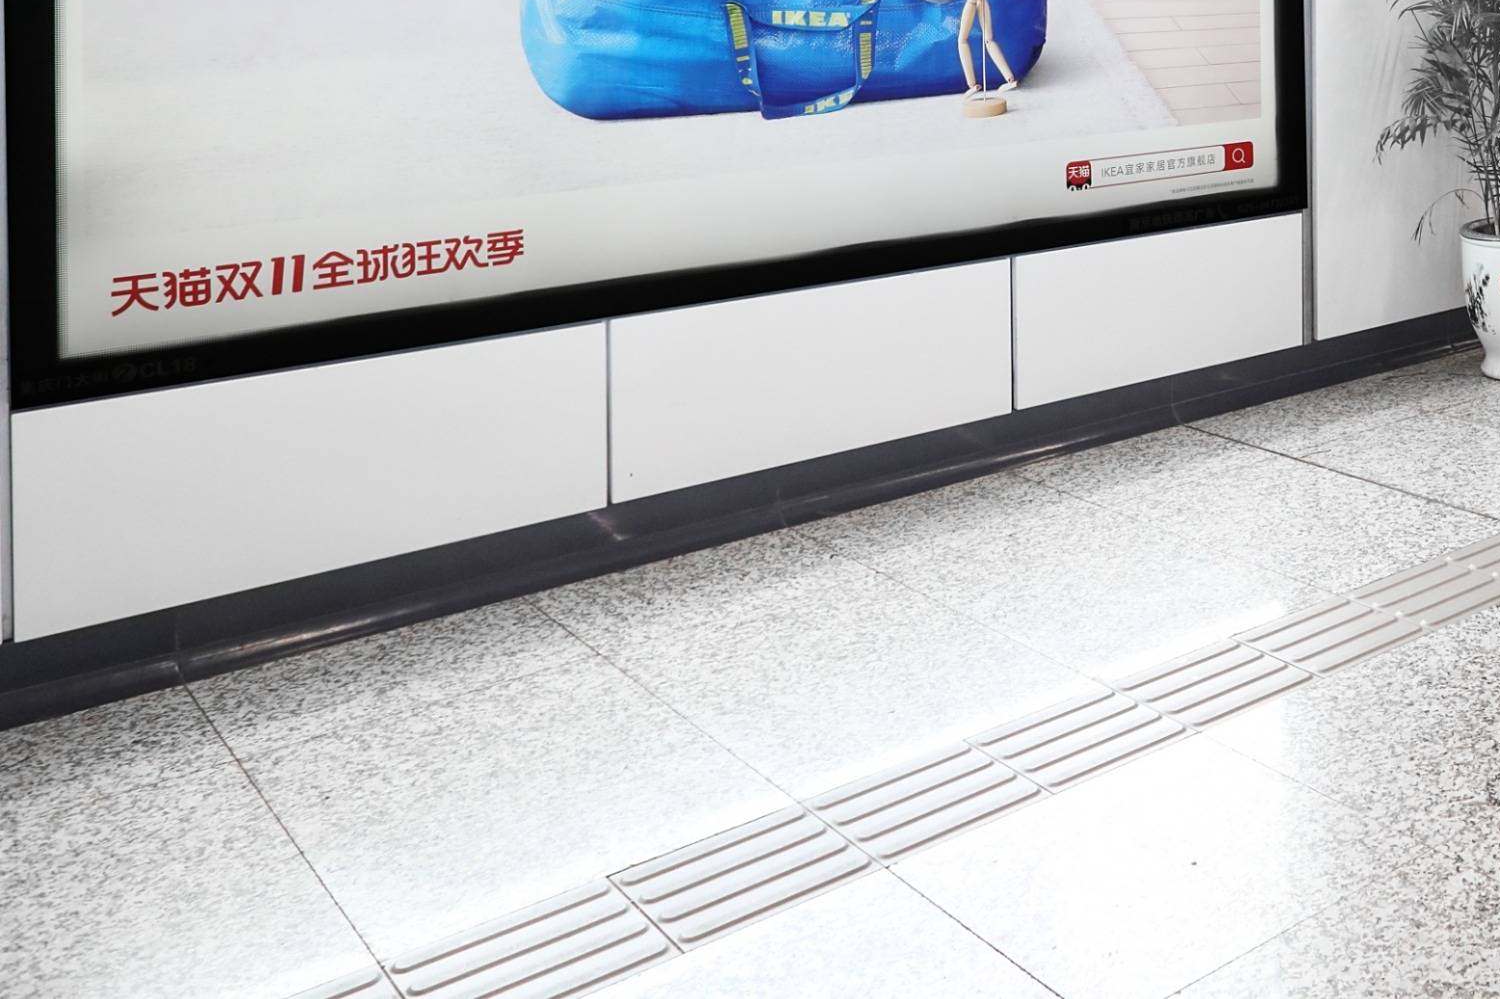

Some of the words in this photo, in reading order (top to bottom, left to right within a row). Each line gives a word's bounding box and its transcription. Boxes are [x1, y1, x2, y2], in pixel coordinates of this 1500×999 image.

[772, 10, 849, 27] IKEA
[1068, 165, 1090, 180] 天猫
[110, 228, 525, 317] 天猫双11全球狂欢季
